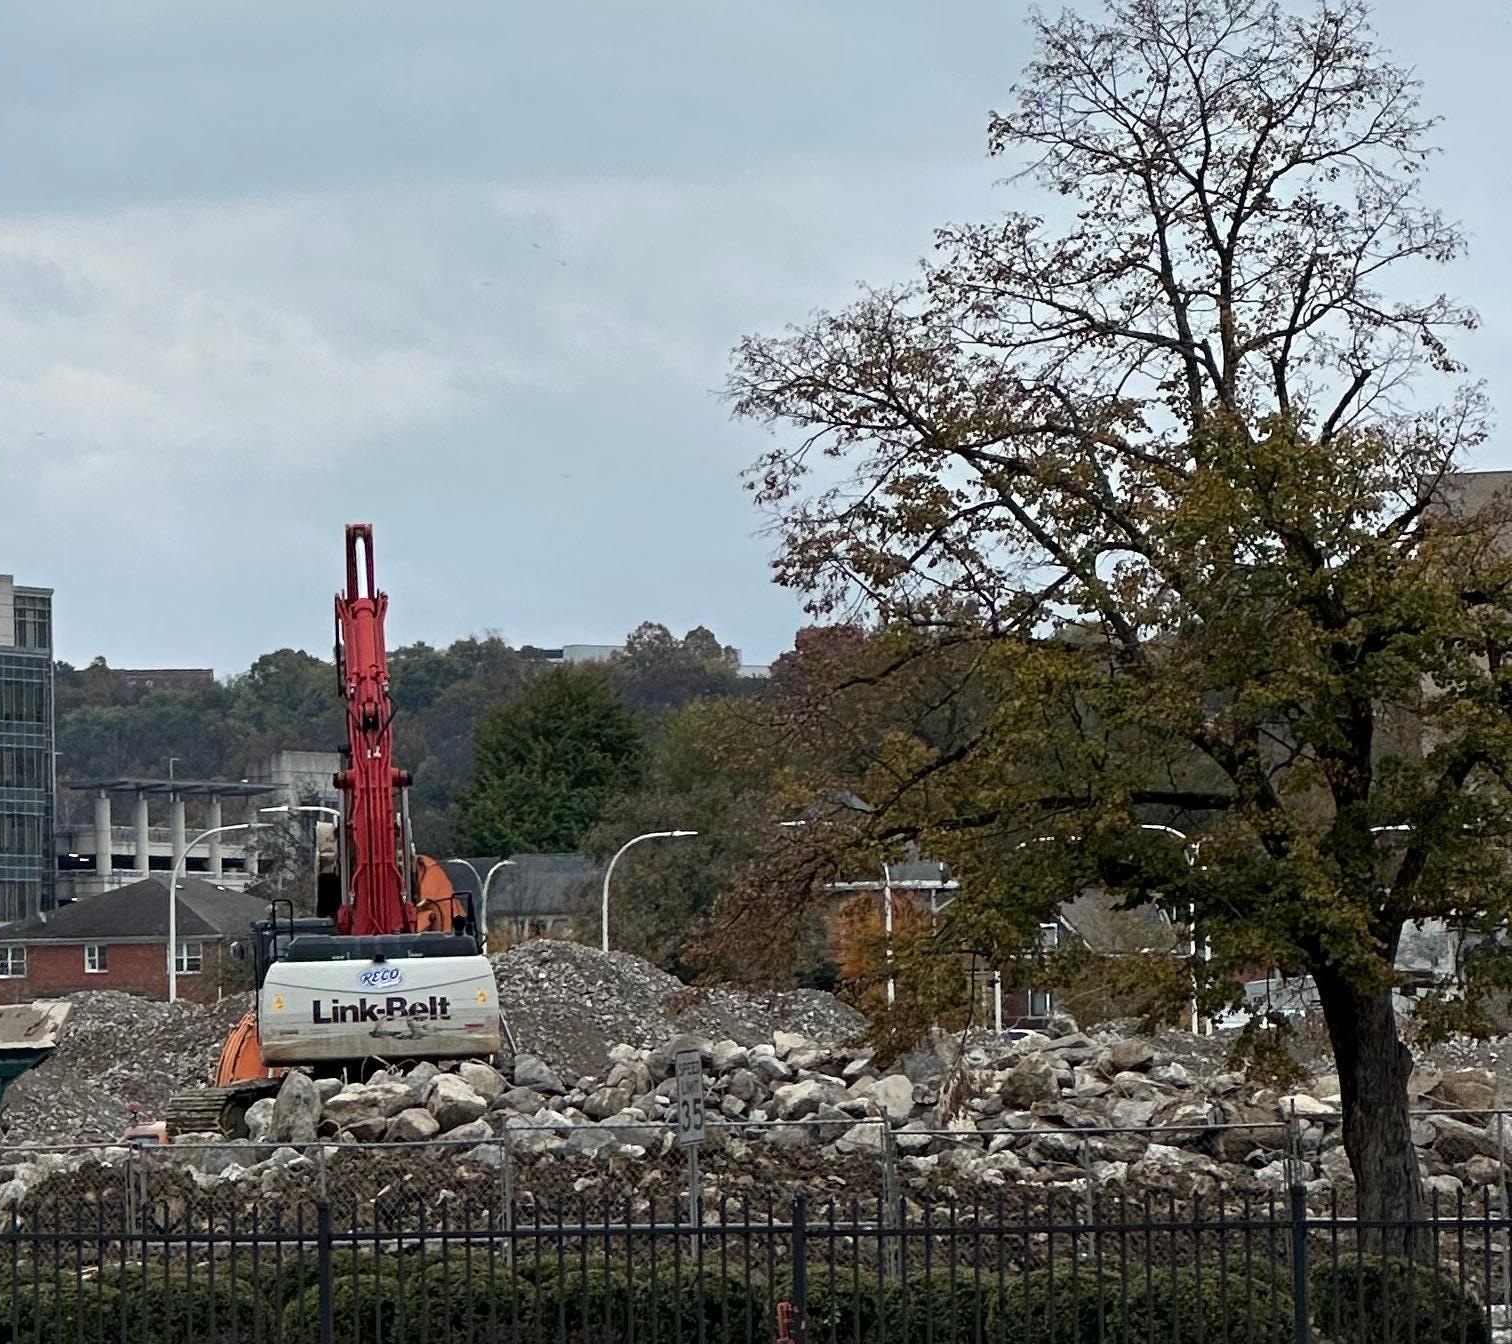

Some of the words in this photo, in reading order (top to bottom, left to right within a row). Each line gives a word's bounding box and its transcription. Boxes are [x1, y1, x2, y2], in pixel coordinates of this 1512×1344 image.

[362, 968, 400, 987] RECO
[312, 996, 451, 1024] Link-Belt
[681, 1098, 703, 1132] 35
